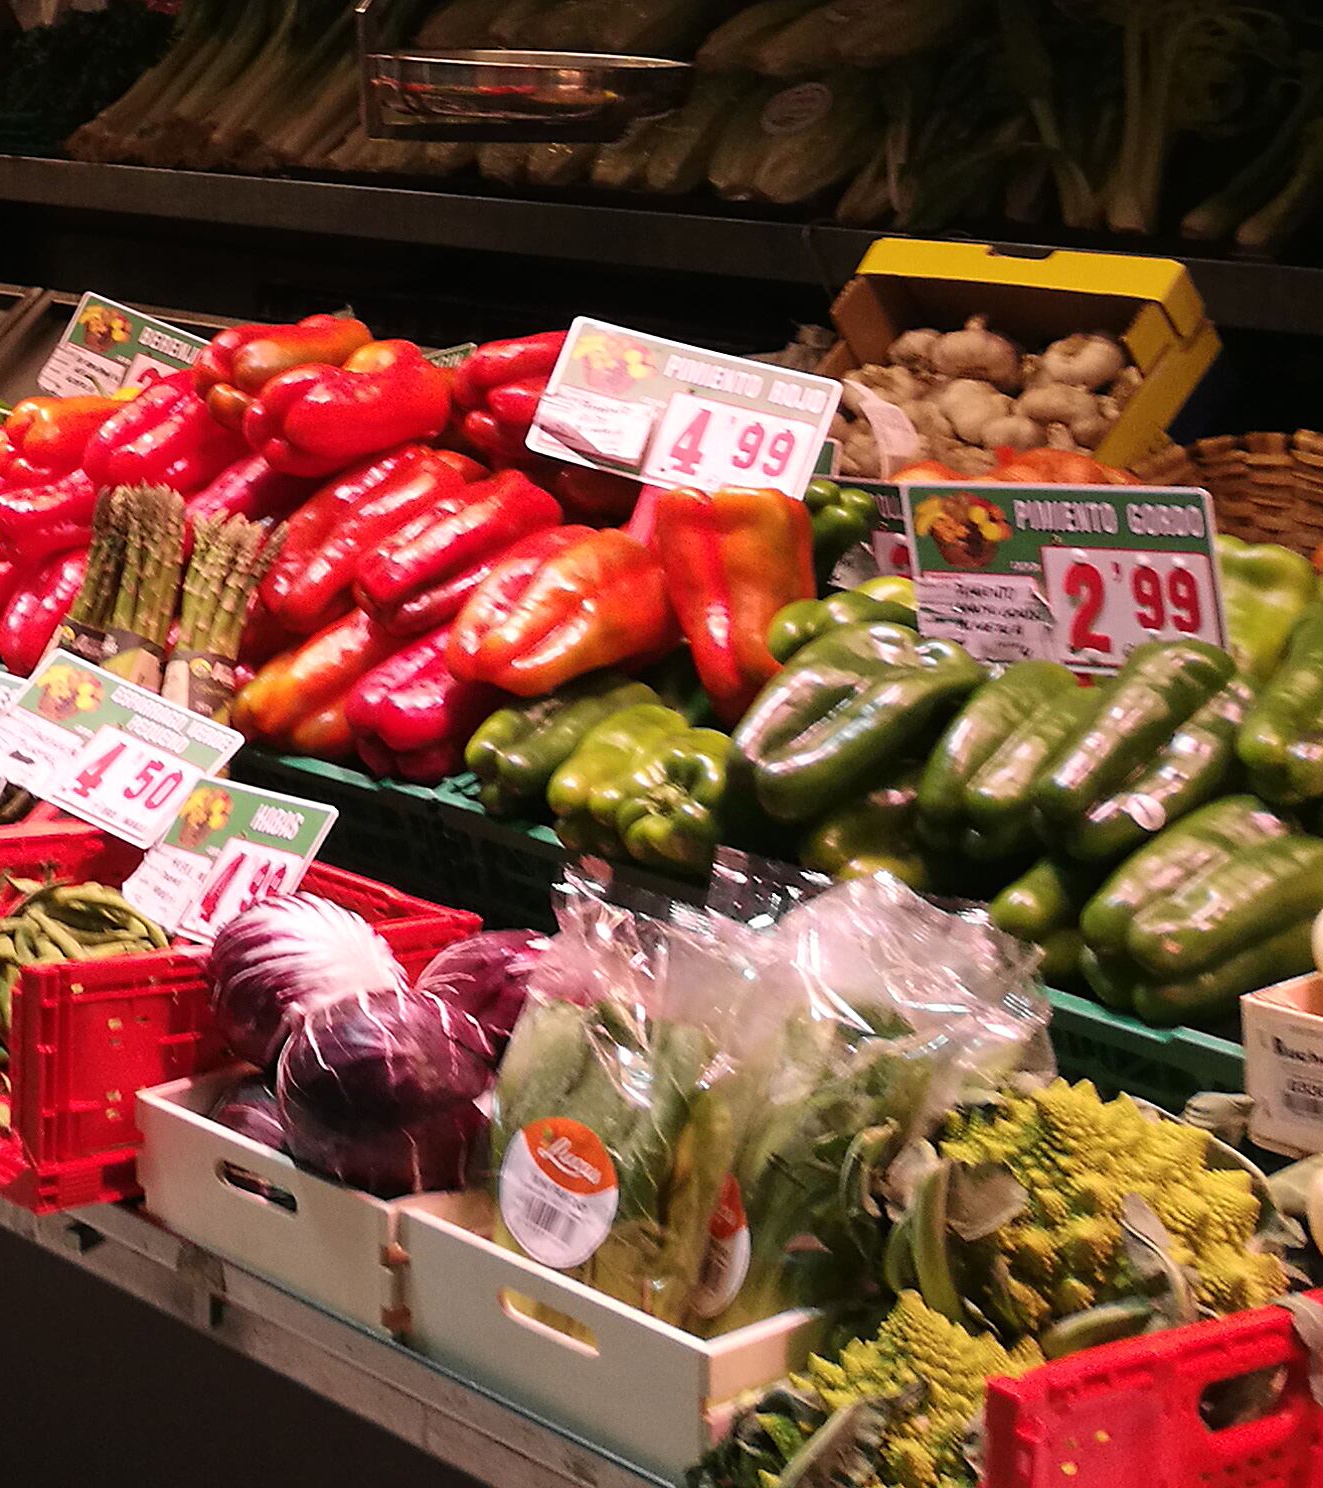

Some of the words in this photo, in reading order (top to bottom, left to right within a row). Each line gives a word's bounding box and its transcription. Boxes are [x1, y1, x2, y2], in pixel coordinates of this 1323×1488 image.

[663, 353, 764, 399] PIMIENTO
[767, 379, 829, 414] ROJO
[669, 407, 796, 477] 4'99
[1012, 499, 1119, 535] PIMIENTO
[1126, 502, 1205, 539] GORDO
[1062, 561, 1201, 654] 2'99
[72, 742, 184, 810] 4'50
